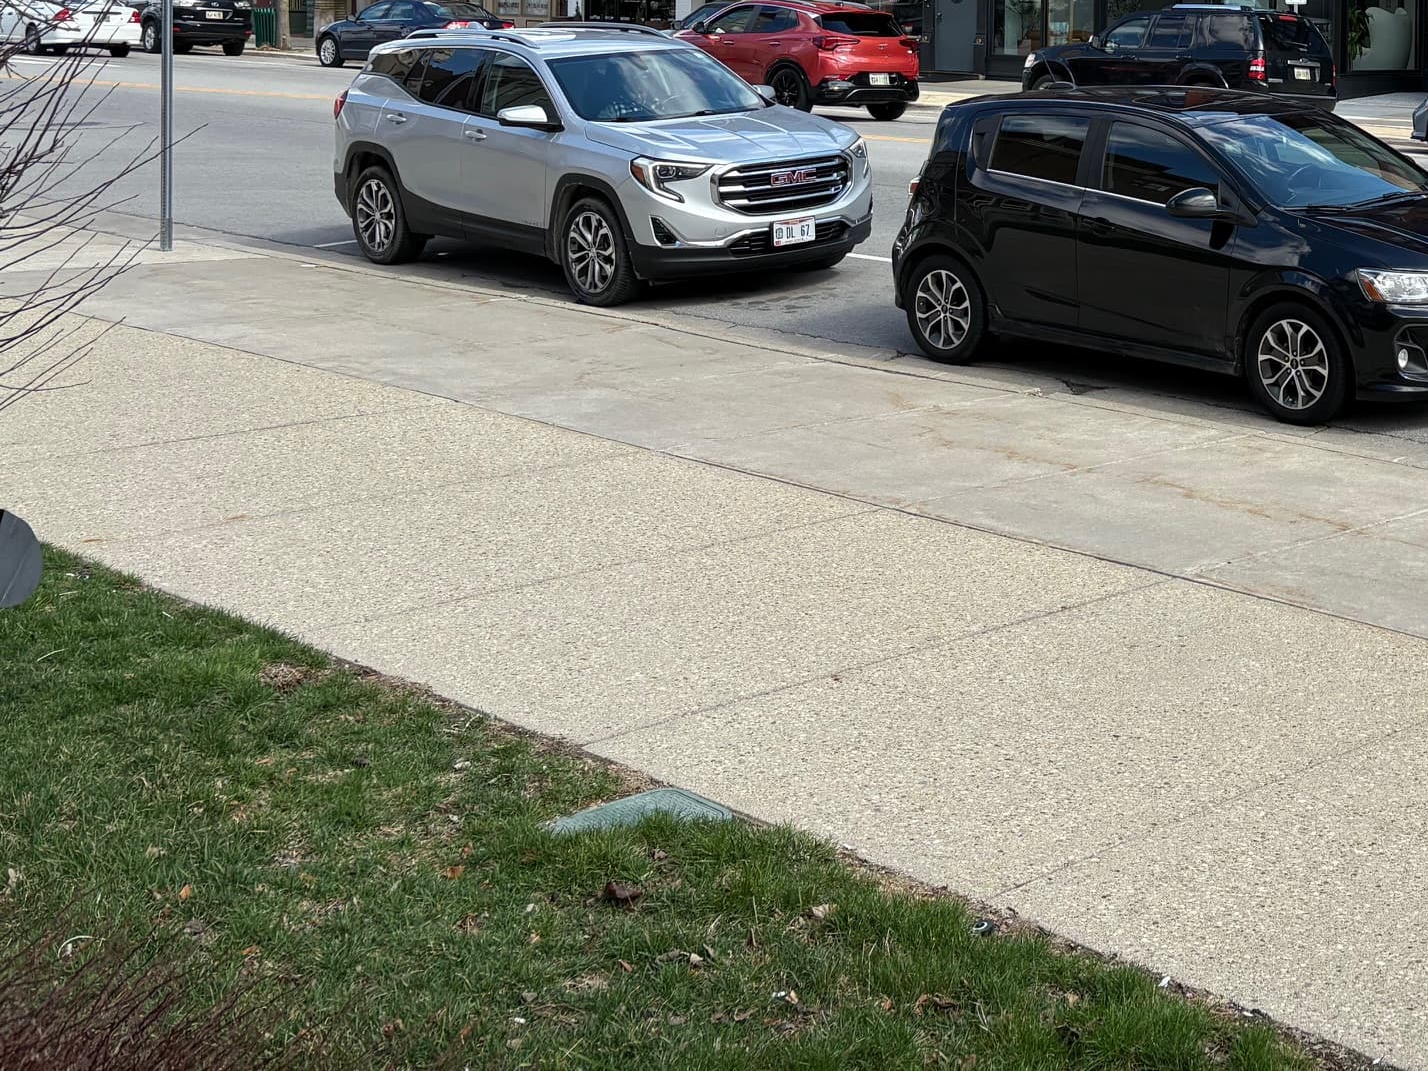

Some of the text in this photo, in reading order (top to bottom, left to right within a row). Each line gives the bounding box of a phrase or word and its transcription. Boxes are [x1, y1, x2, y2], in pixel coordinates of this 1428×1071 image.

[771, 168, 816, 186] GMC
[786, 226, 795, 239] DL
[801, 224, 810, 236] 67
